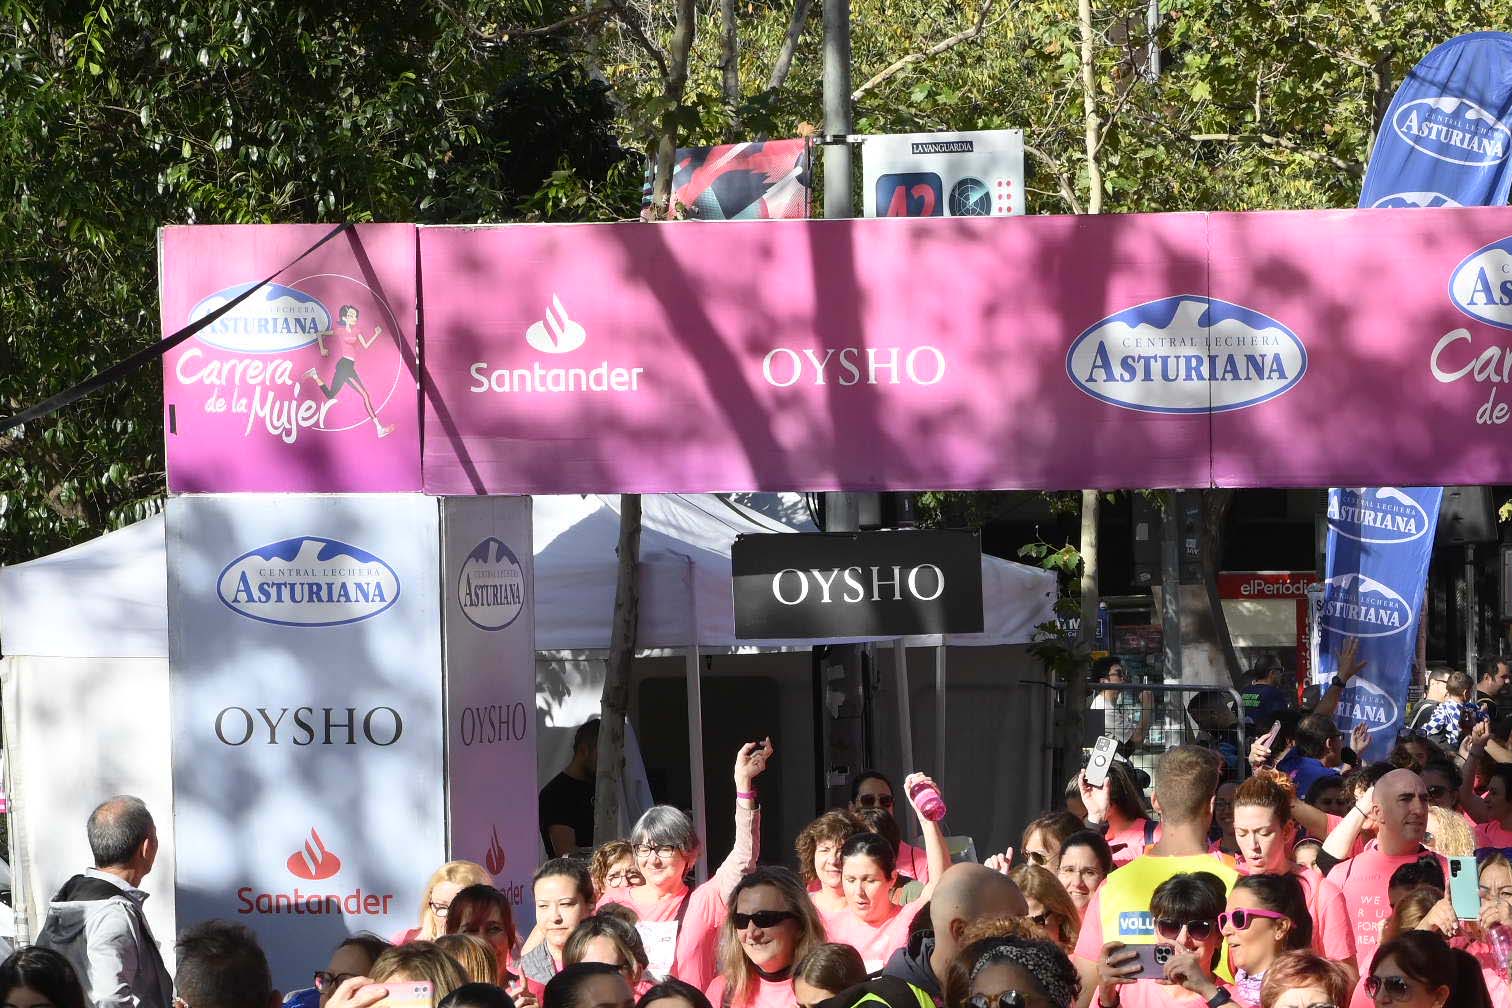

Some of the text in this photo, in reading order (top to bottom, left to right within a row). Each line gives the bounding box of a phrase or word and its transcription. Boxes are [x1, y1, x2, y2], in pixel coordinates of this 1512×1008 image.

[1401, 109, 1503, 157] ASTURIANA
[1121, 335, 1280, 348] CENTRAL LECHERA
[175, 349, 294, 385] Carrera
[470, 360, 643, 394] Santander
[763, 346, 947, 388] OYSHO
[1085, 340, 1289, 384] ASTURIANA
[205, 382, 338, 444] de la Mujer
[1476, 388, 1510, 425] de
[1327, 495, 1417, 534] ASTURIANA
[231, 570, 387, 604] ASTURIANA
[259, 567, 380, 578] CENTRAL LECHERA
[772, 563, 946, 606] OYSHO
[464, 576, 521, 608] ASTURIANA
[1323, 599, 1401, 627] STURIANA
[214, 706, 403, 746] OYSHO
[460, 702, 527, 747] OYSHO
[237, 886, 394, 915] Santander
[1120, 917, 1156, 930] VOLU
